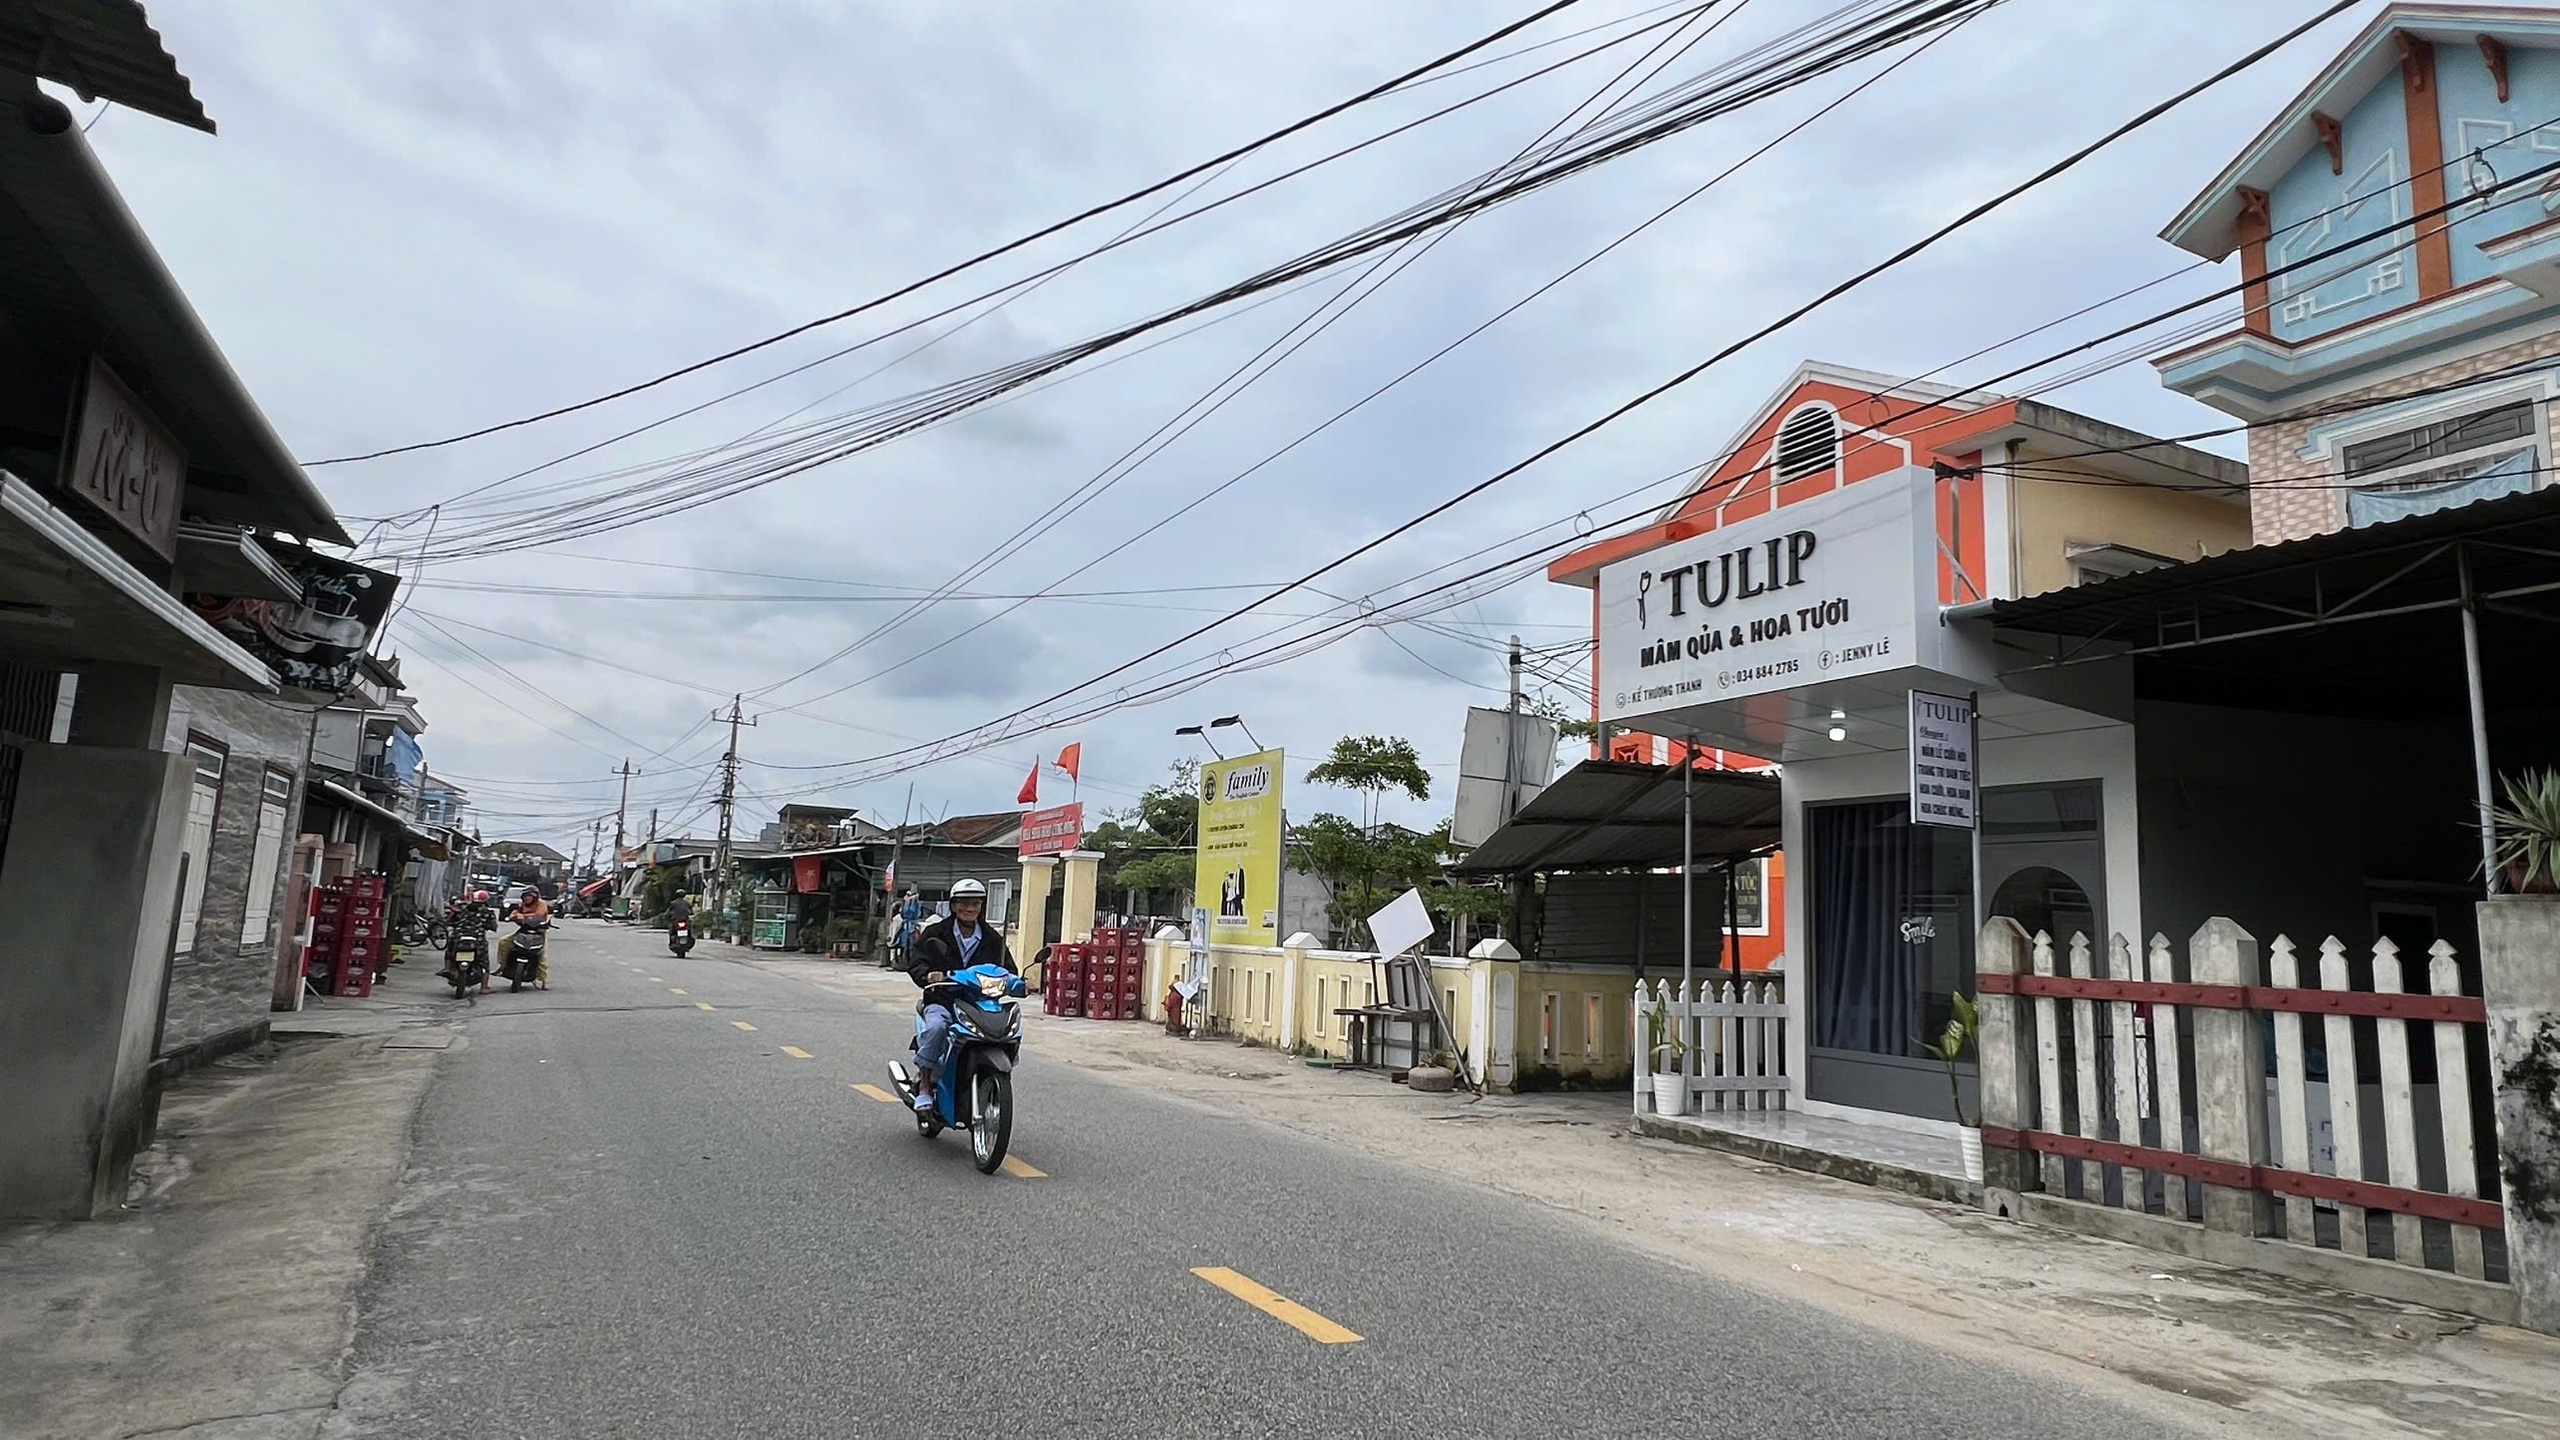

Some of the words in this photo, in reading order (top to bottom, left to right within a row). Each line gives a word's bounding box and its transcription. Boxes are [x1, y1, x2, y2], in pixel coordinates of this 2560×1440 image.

[1660, 530, 1816, 617] TULIP
[1640, 637, 1681, 668] MÂM
[1729, 625, 1744, 648] &
[1750, 613, 1792, 643] HOA
[1796, 597, 1849, 632] TƯƠI
[1842, 643, 1873, 663] JENNY
[1736, 668, 1753, 683] 034
[1756, 664, 1773, 679] 884
[1775, 659, 1799, 676] 2785
[1923, 701, 1971, 724] TULIP
[1225, 766, 1269, 797] family
